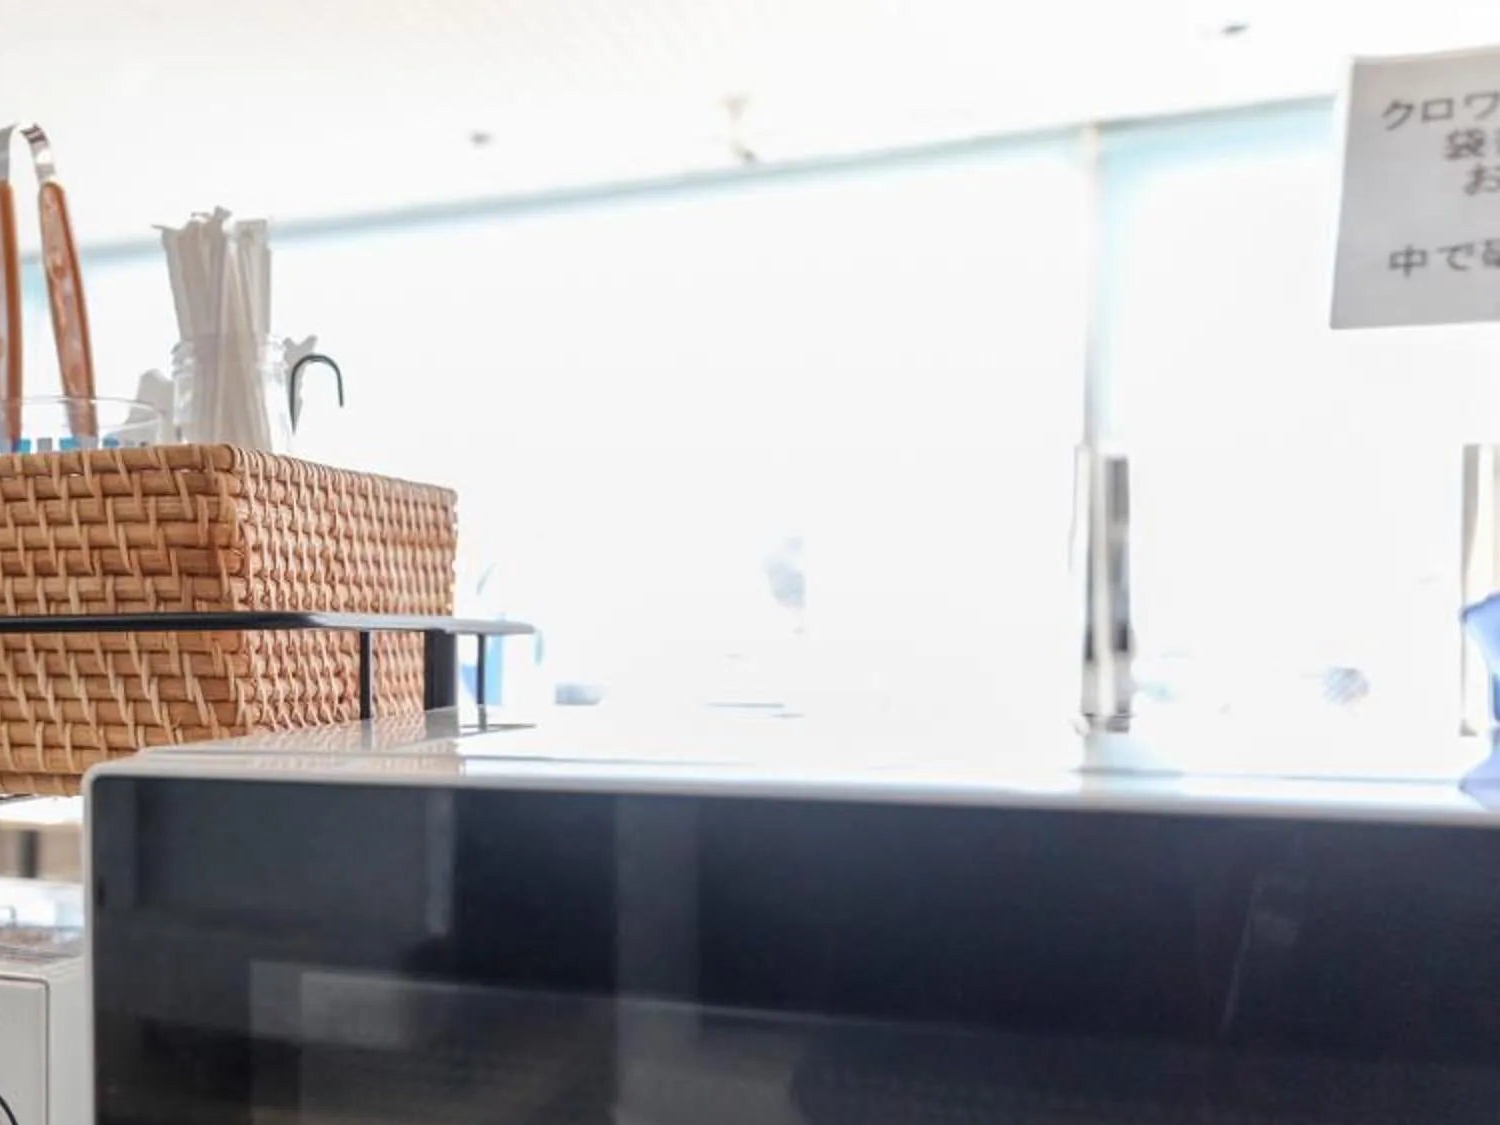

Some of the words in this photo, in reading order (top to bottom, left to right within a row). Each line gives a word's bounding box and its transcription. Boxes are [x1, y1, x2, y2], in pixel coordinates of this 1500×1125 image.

[1381, 91, 1500, 131] クロワ
[1444, 127, 1500, 161] 袋
